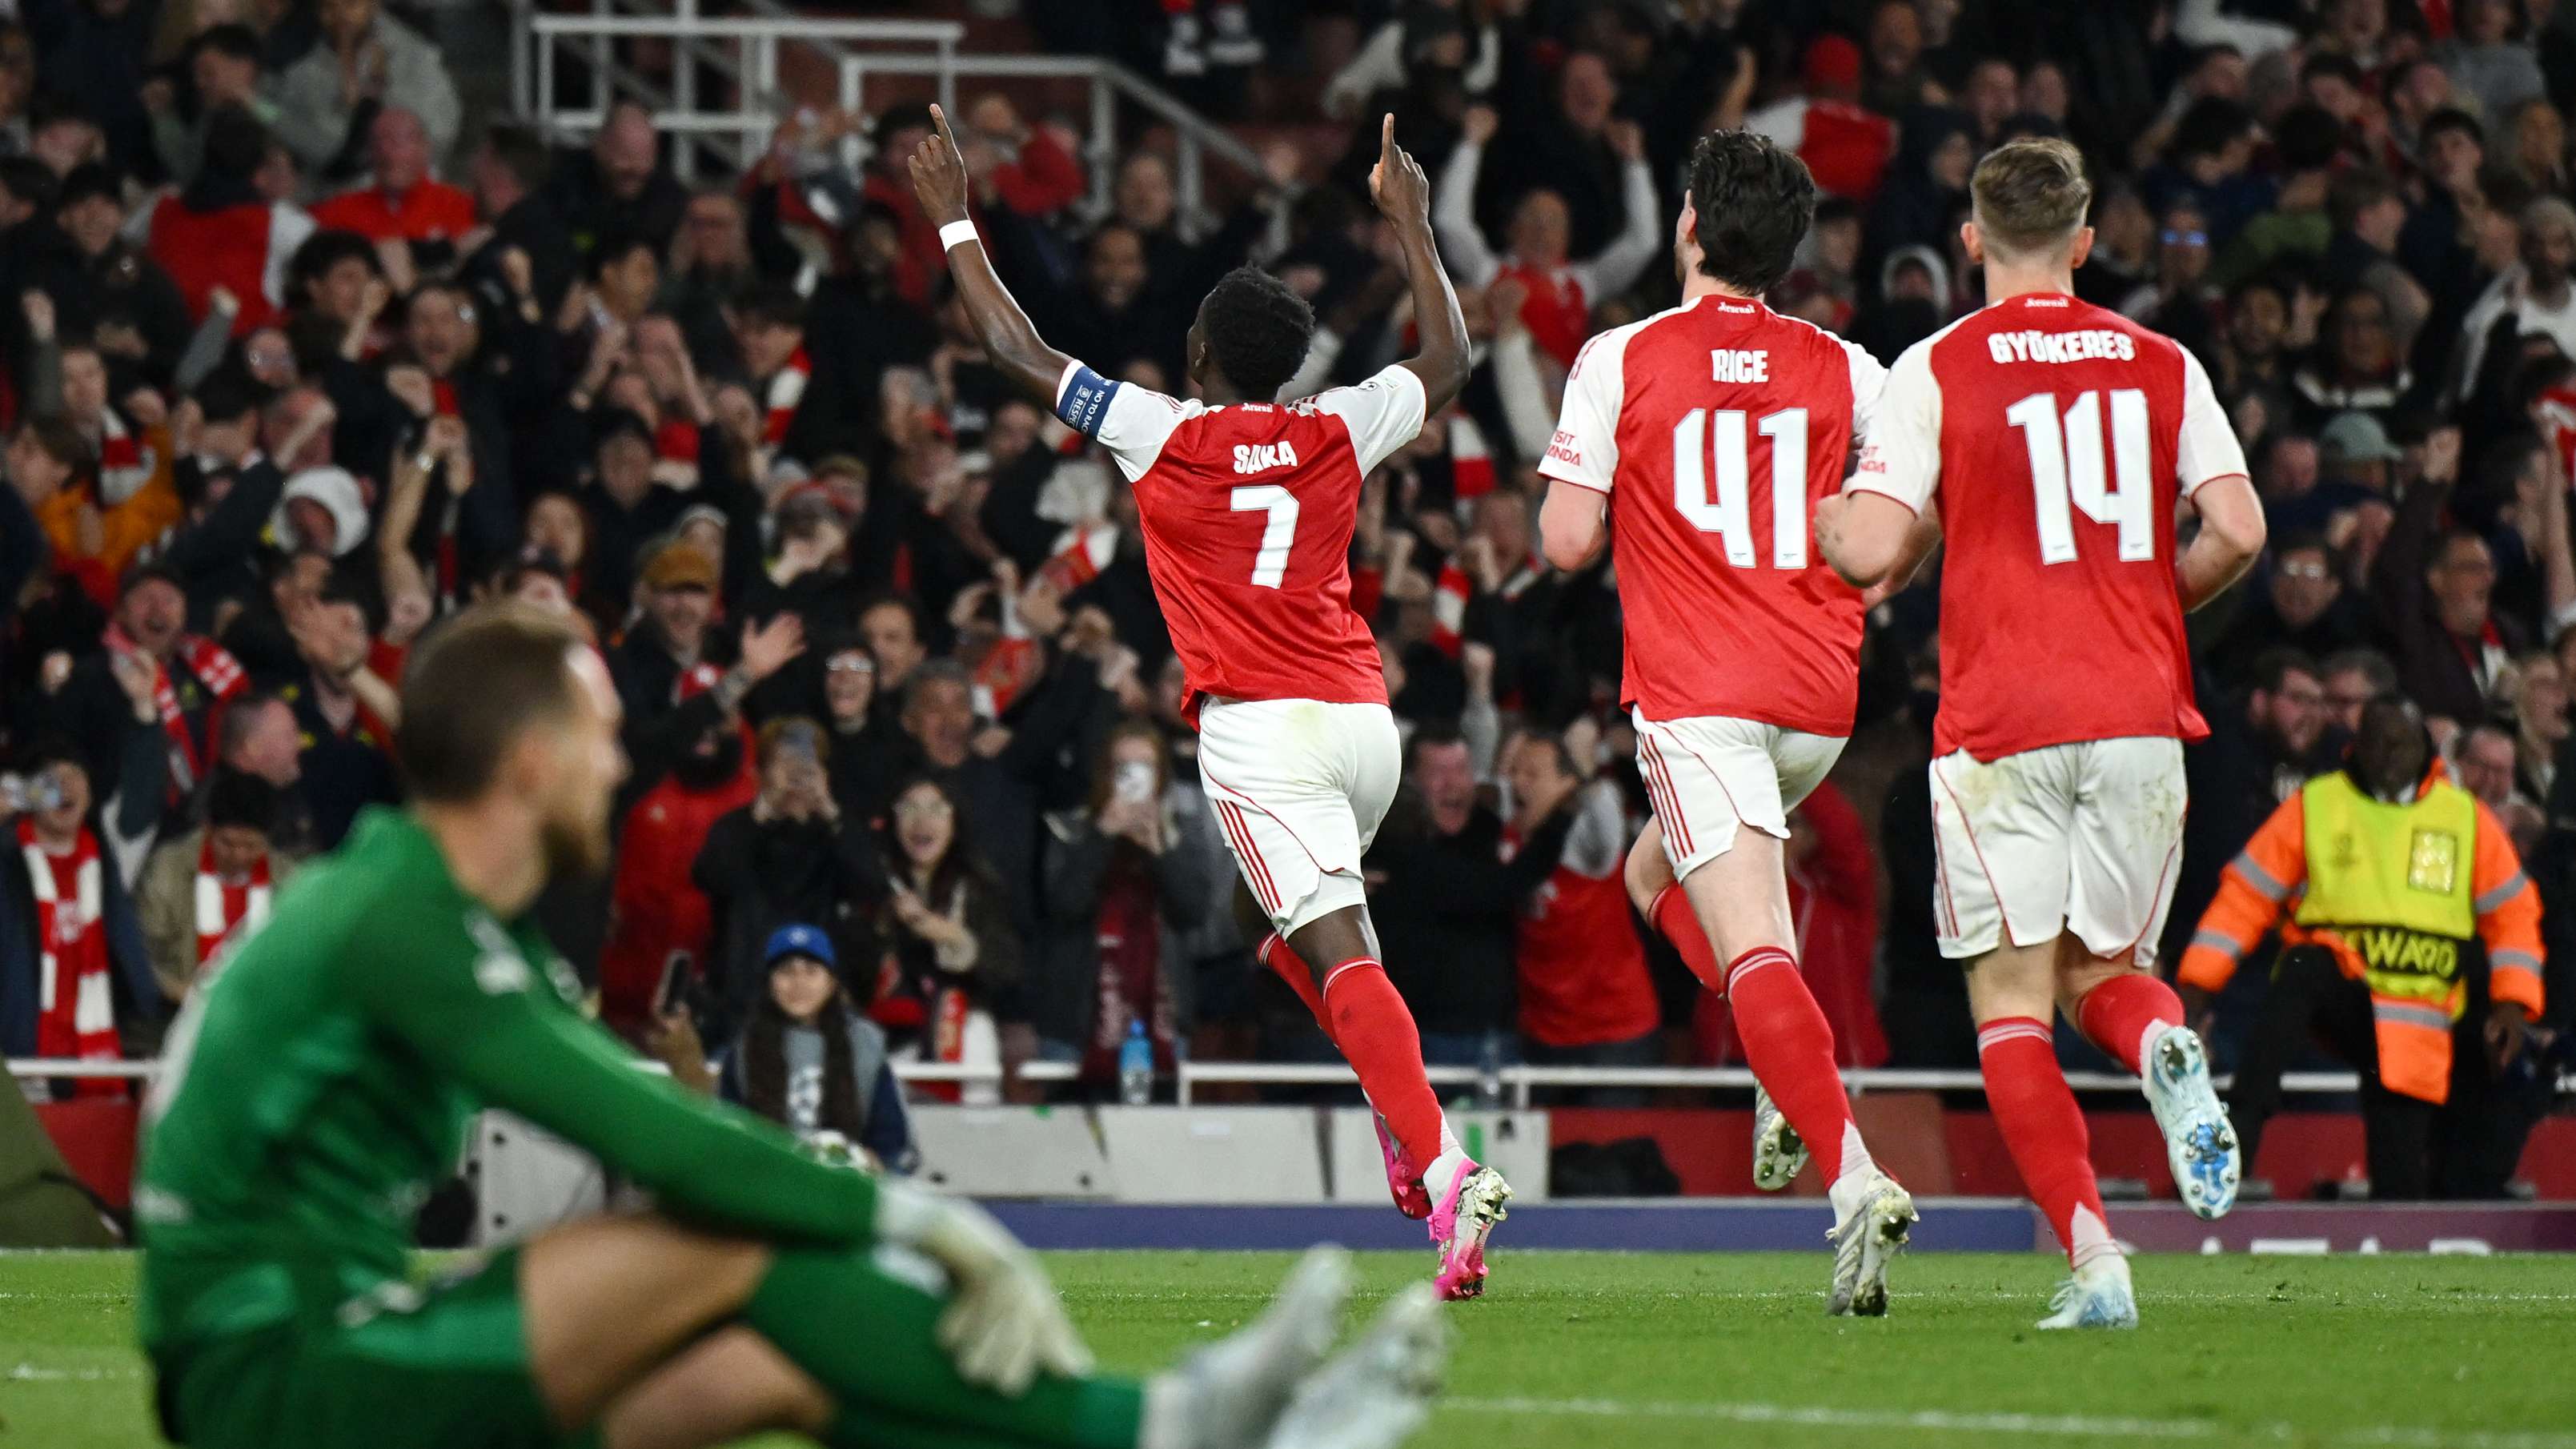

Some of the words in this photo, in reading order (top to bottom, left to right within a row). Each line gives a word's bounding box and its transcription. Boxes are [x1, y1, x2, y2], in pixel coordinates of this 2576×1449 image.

[1987, 329, 2136, 364] GYÖKERES
[1711, 348, 1769, 383] RICE
[1068, 398, 1084, 429] RESPEC
[1087, 403, 1098, 415] TO
[1093, 389, 1105, 403] NO
[1081, 414, 1093, 433] RAC
[1233, 440, 1298, 474] SAKA
[1674, 407, 1808, 569] 41
[2005, 388, 2155, 565] 14
[1230, 484, 1300, 589] 7
[2363, 928, 2458, 978] WARD
